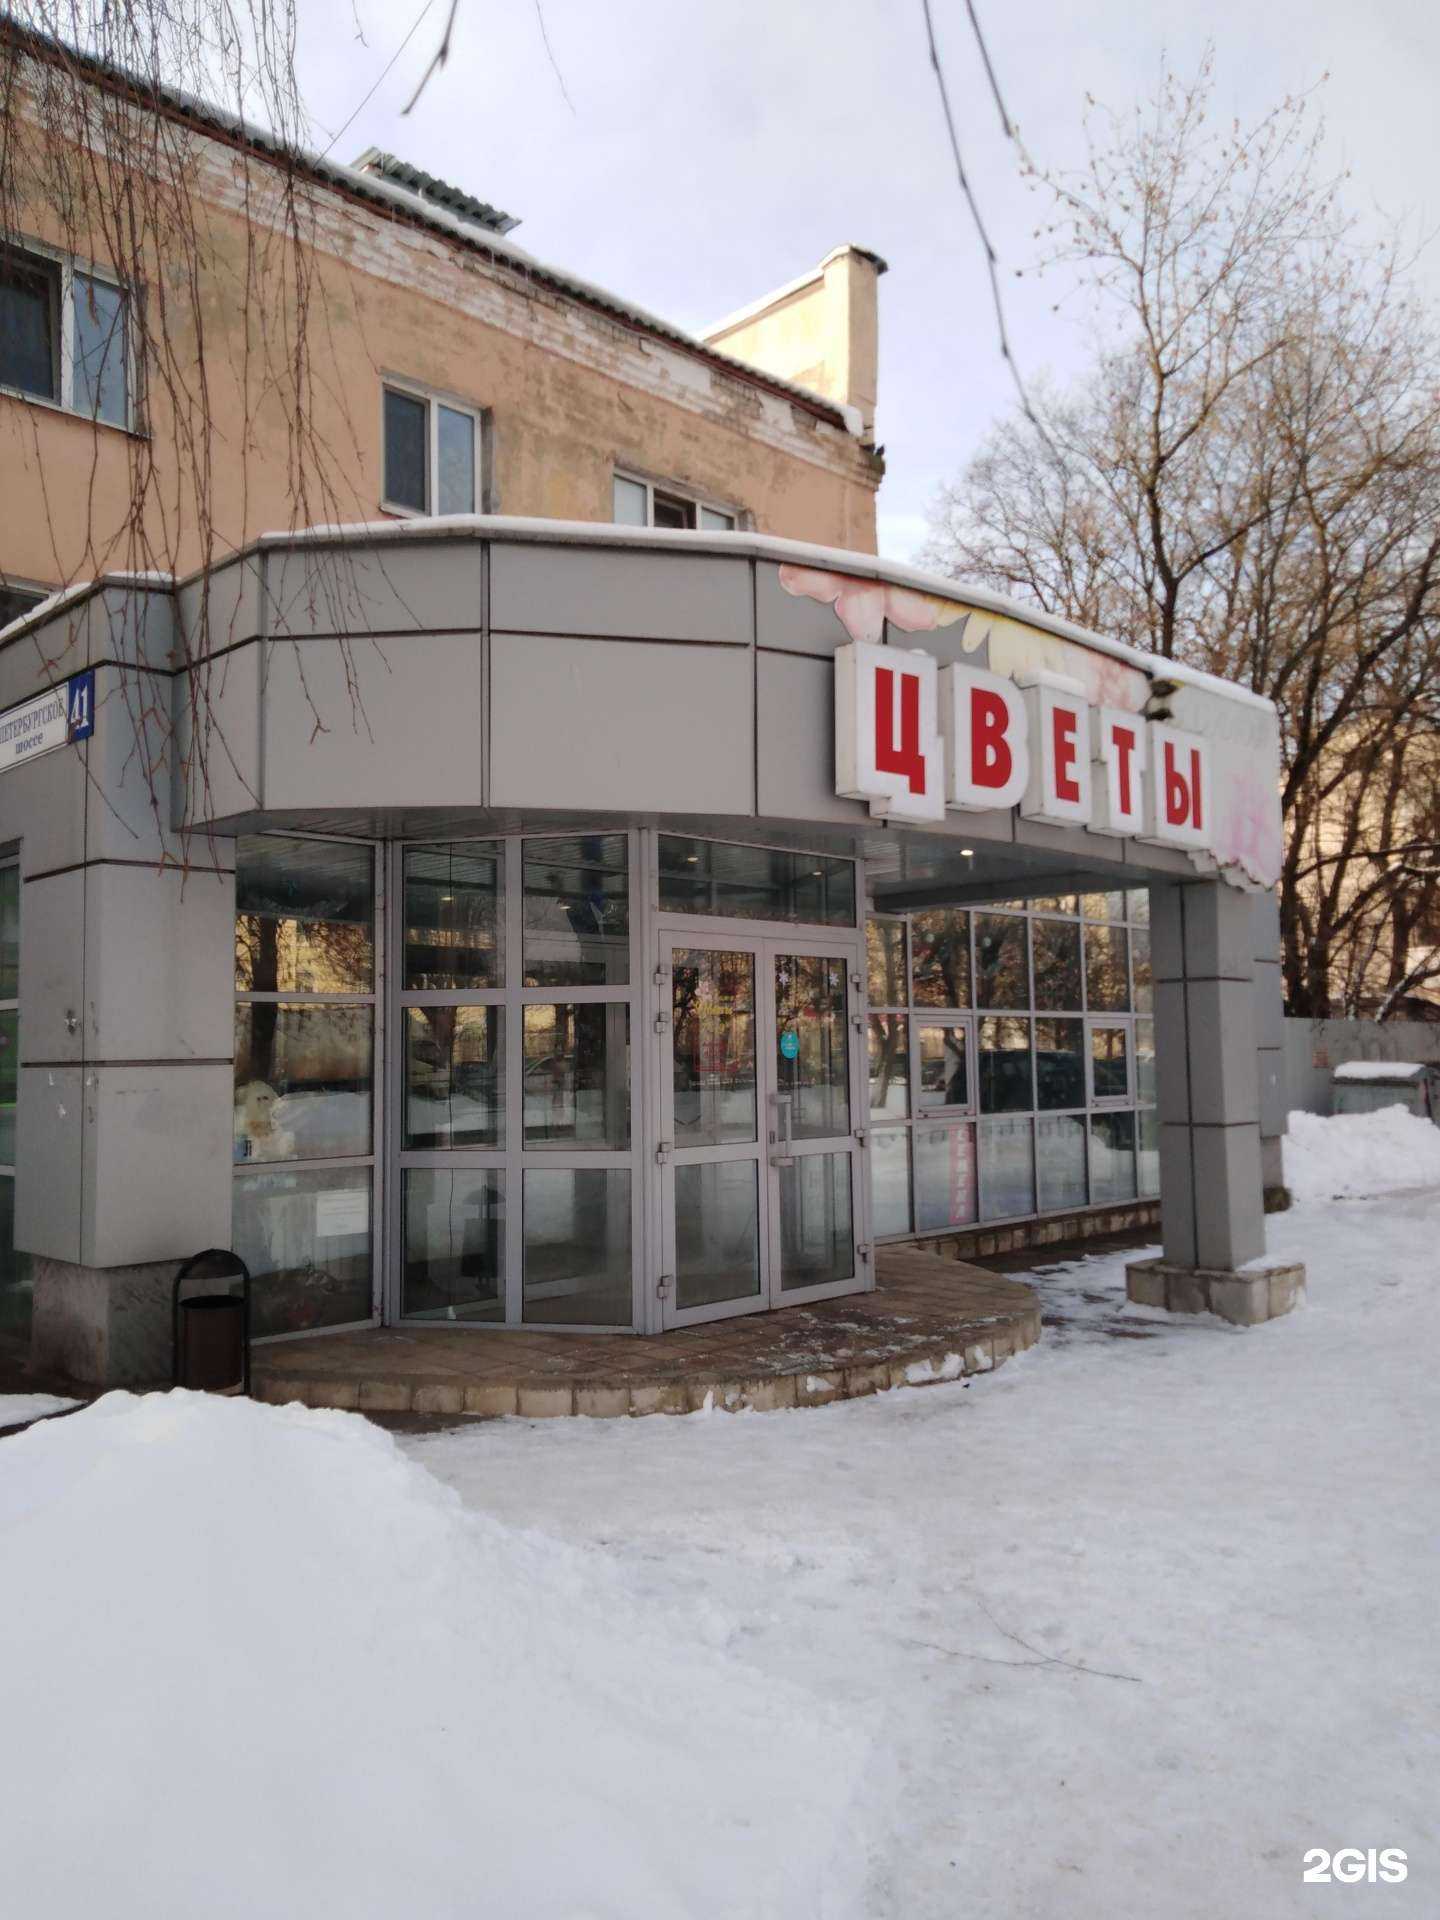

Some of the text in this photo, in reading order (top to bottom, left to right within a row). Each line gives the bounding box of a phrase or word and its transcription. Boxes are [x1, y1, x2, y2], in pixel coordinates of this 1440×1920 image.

[70, 685, 89, 730] 41
[15, 732, 44, 754] шоссе
[875, 667, 1202, 830] ЦВЕТЫ
